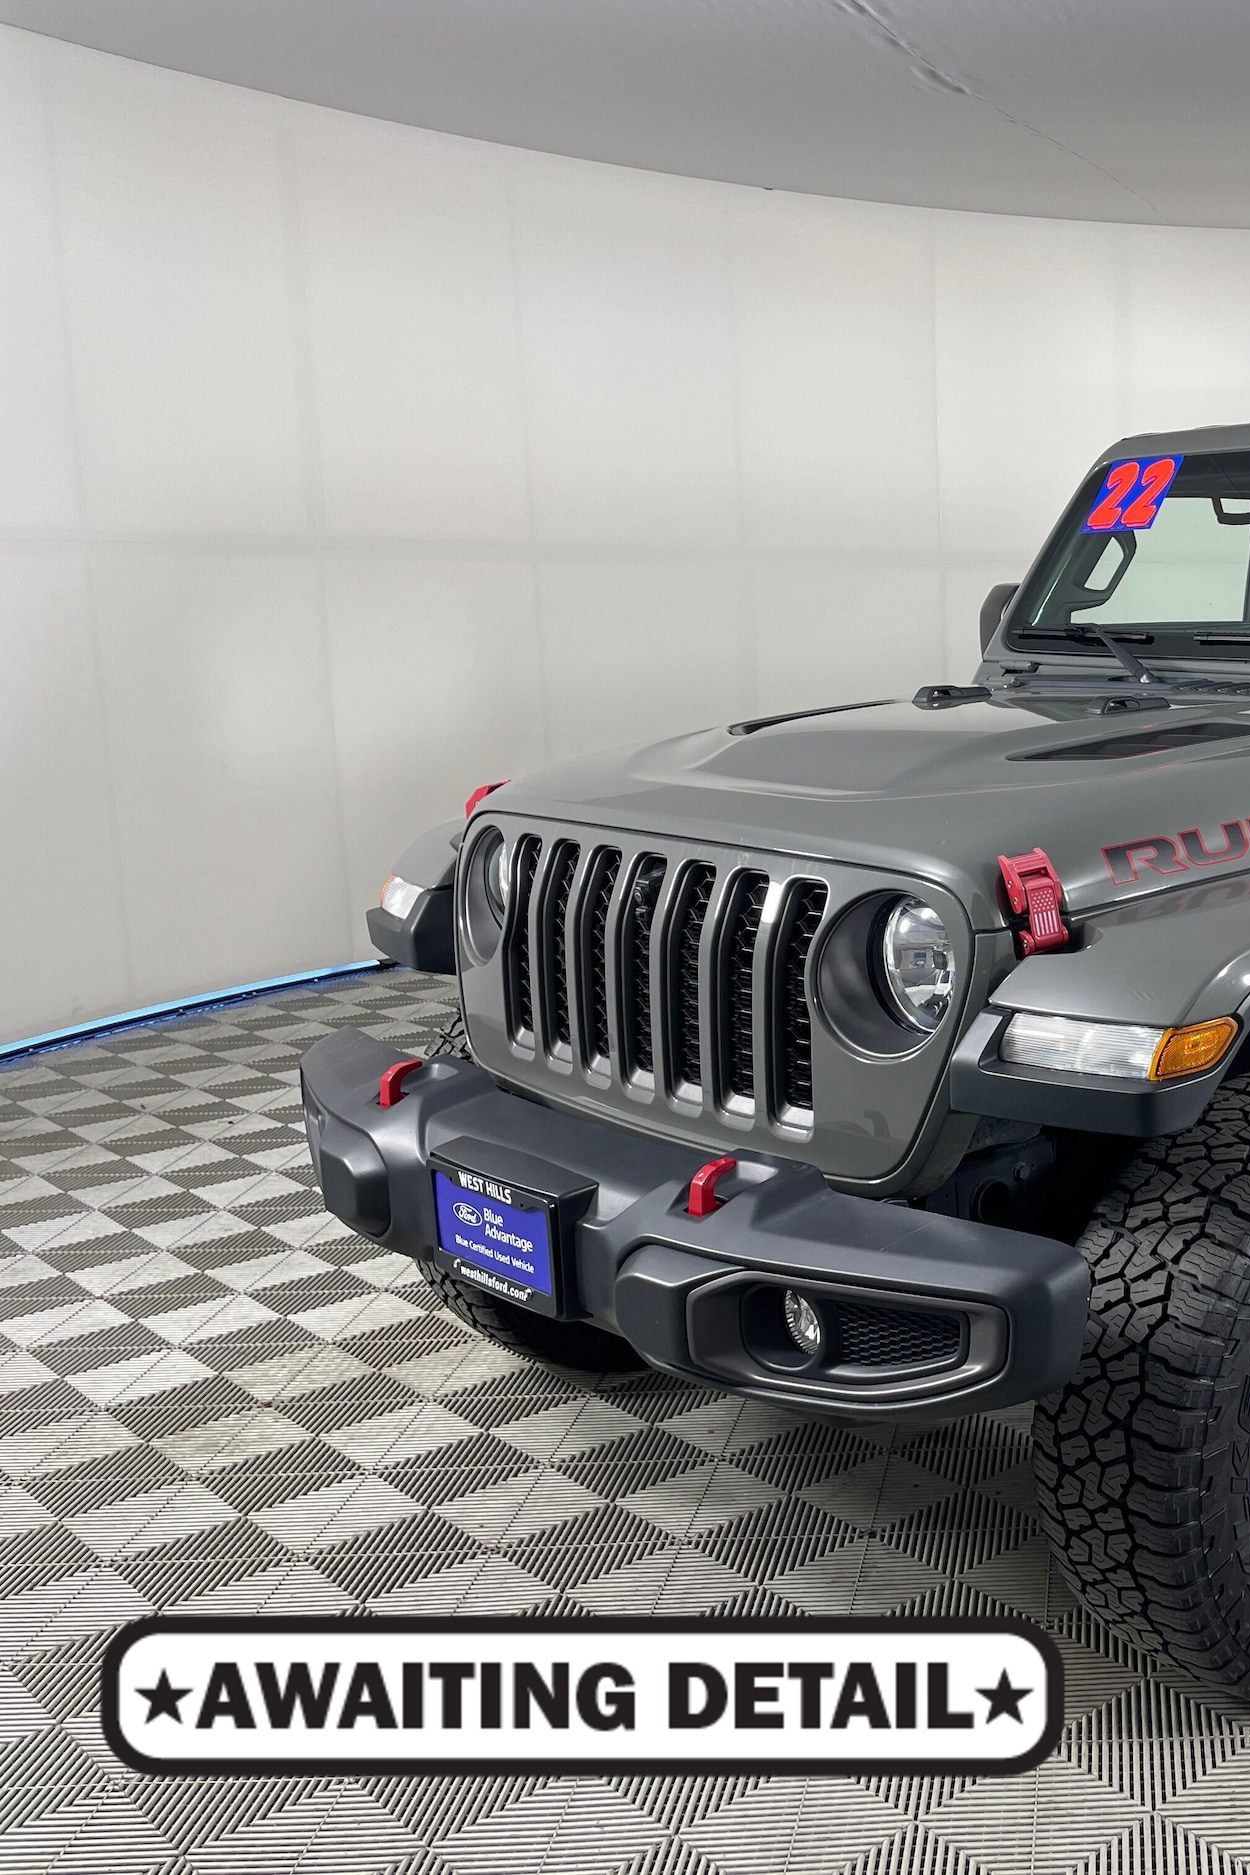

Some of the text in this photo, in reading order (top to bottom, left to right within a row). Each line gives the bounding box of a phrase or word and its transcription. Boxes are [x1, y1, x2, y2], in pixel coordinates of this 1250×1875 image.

[1086, 458, 1176, 530] 22
[458, 1171, 512, 1205] WEST HILLS
[483, 1207, 504, 1227] Blue
[455, 1234, 535, 1274] Blue Certified Used Vehicle
[484, 1223, 534, 1253] Advantage
